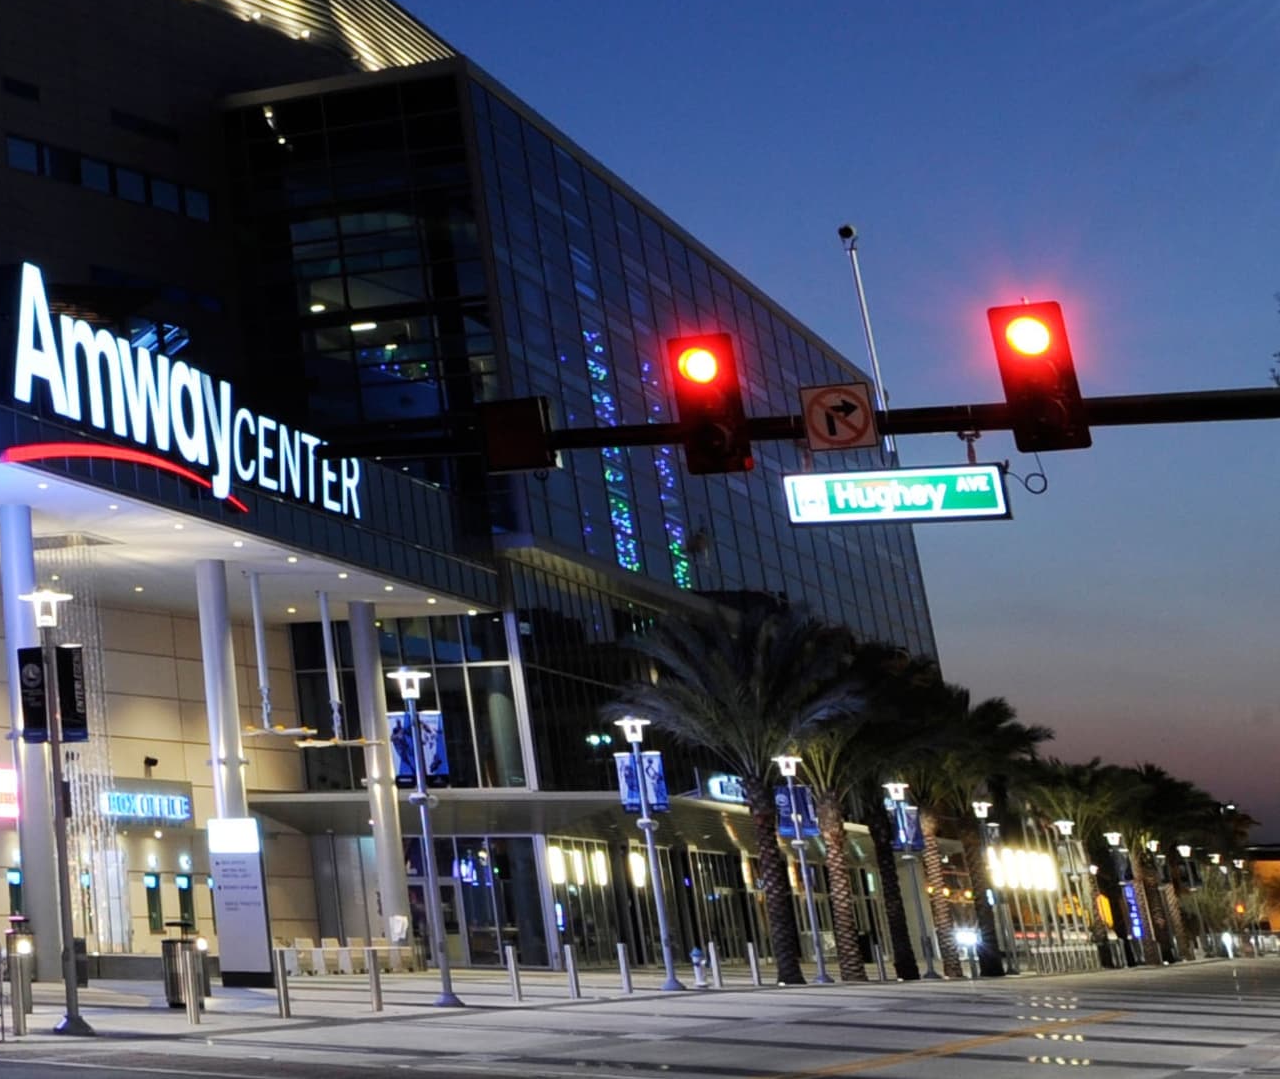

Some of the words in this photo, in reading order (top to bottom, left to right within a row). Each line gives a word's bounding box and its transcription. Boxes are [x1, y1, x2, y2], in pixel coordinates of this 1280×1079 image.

[14, 261, 232, 499] Amway
[233, 408, 361, 520] CENTER
[833, 480, 946, 512] Hughey
[956, 476, 990, 493] AVE
[105, 792, 137, 815] BOX
